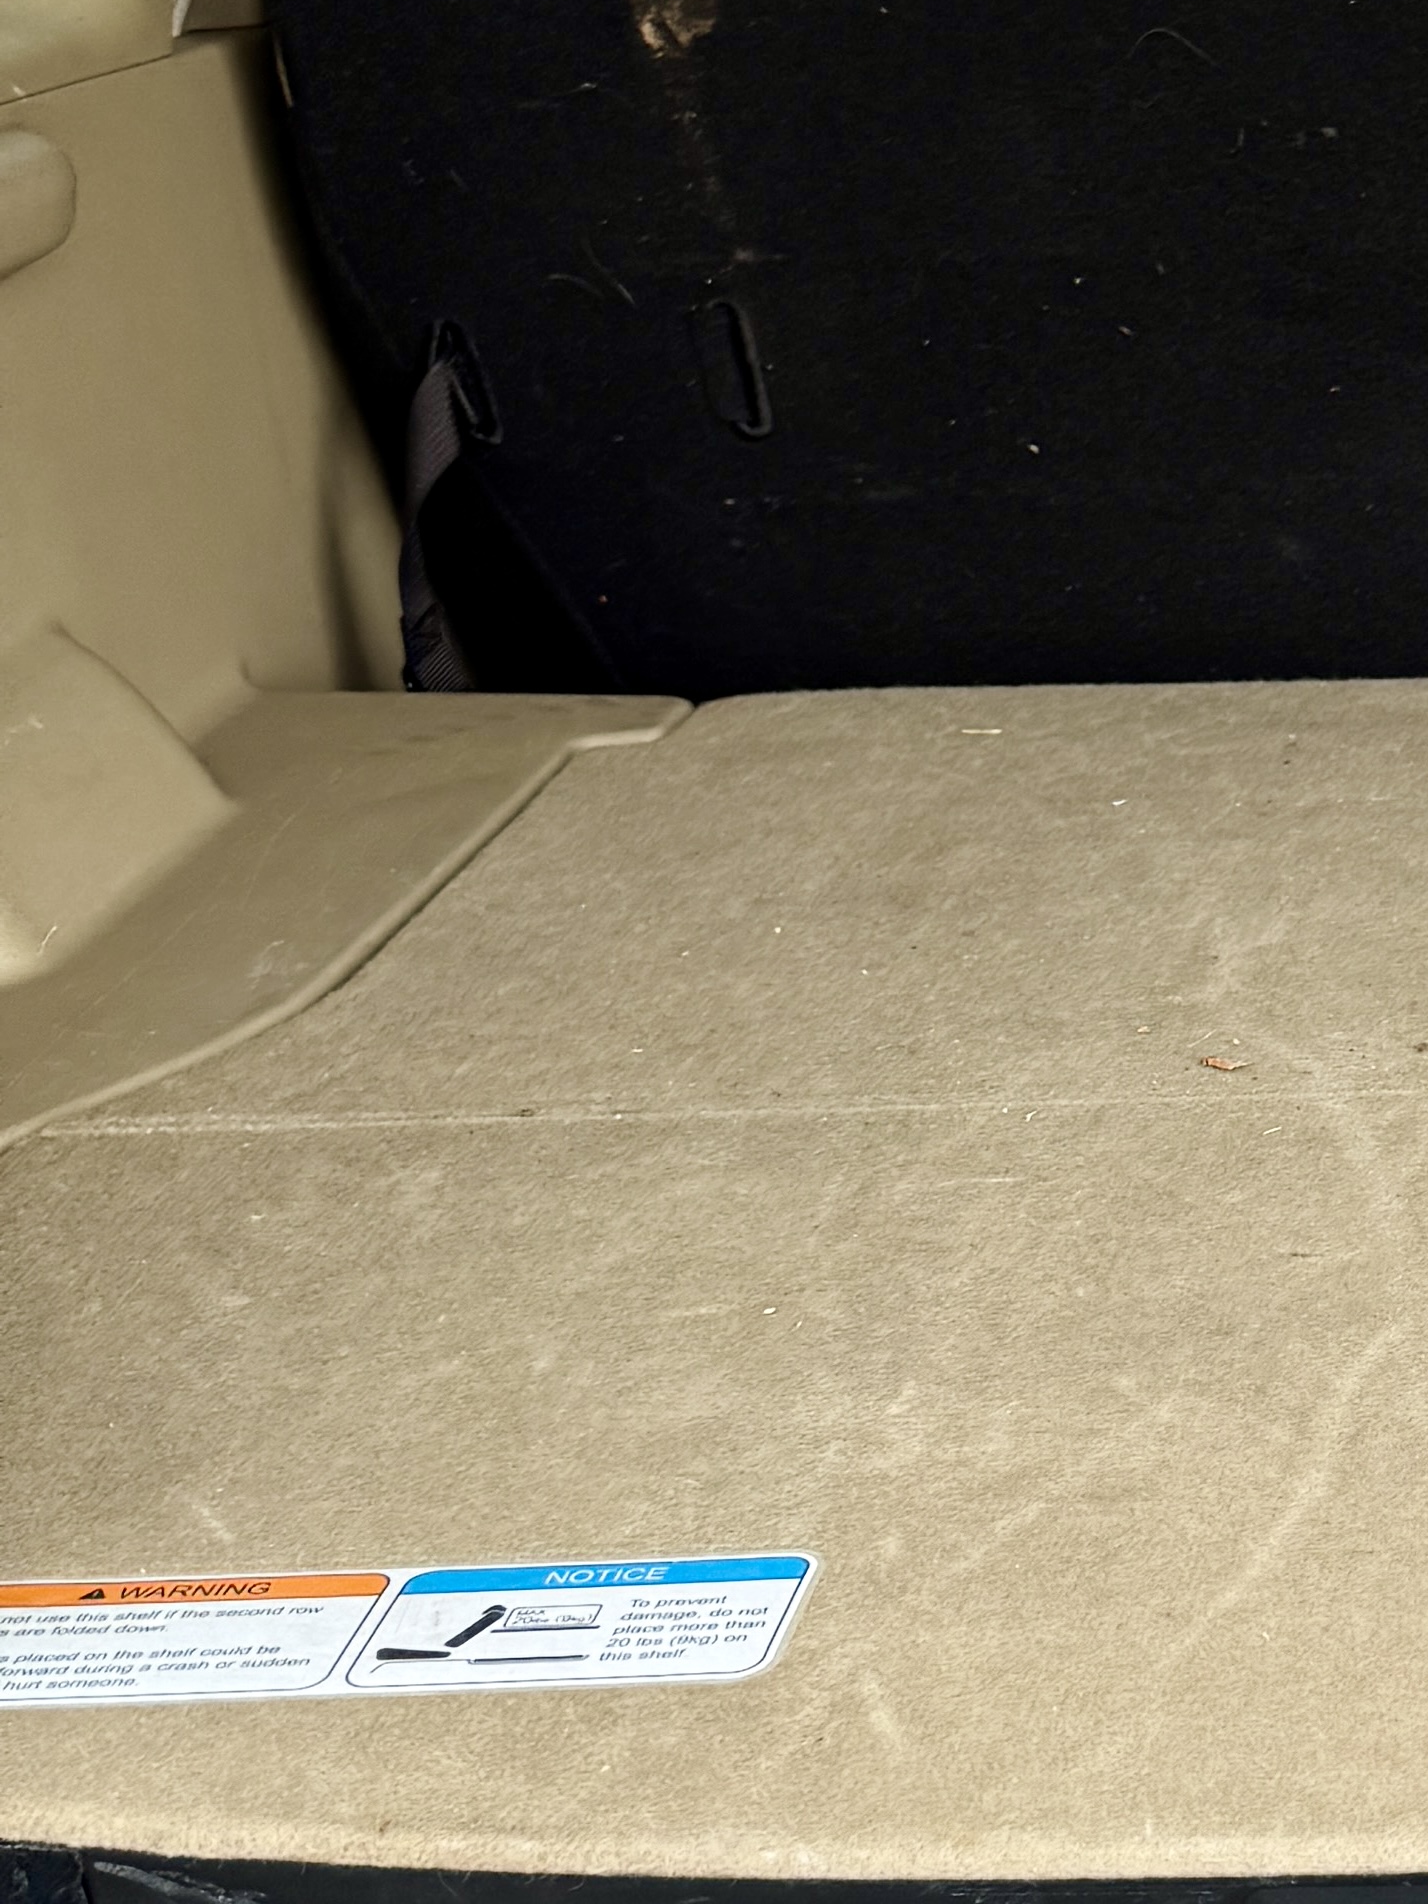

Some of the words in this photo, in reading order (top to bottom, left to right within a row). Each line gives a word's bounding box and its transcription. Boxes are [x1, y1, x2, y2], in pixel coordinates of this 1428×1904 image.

[544, 1566, 670, 1585] NOTICE
[120, 1581, 272, 1600] WARNING
[631, 1598, 650, 1608] To
[654, 1596, 727, 1609] prevent
[0, 1614, 32, 1625] not
[36, 1614, 70, 1624] use
[76, 1612, 109, 1622] this
[113, 1610, 162, 1621] shelf
[164, 1609, 179, 1620] if
[181, 1609, 209, 1619] the
[215, 1606, 285, 1617] second
[288, 1606, 324, 1614] row
[620, 1610, 702, 1622] damage,
[709, 1608, 733, 1617] do
[738, 1607, 769, 1616] not
[14, 1628, 46, 1637] are
[51, 1624, 112, 1636] folded
[612, 1624, 664, 1636] place
[670, 1622, 719, 1632] more
[725, 1620, 767, 1629] than
[606, 1637, 631, 1648] 20
[636, 1637, 663, 1647] lbs
[724, 1634, 748, 1643] on
[13, 1652, 81, 1664] placed
[84, 1653, 108, 1661] on
[113, 1650, 144, 1660] the
[149, 1647, 198, 1659] shelf
[200, 1645, 253, 1656] could
[256, 1645, 281, 1655] be
[599, 1651, 632, 1661] this
[74, 1663, 134, 1675] during
[138, 1664, 151, 1673] a
[157, 1660, 209, 1672] crash
[215, 1660, 237, 1669] or
[240, 1657, 311, 1668] sudden
[3, 1679, 42, 1690] hurt
